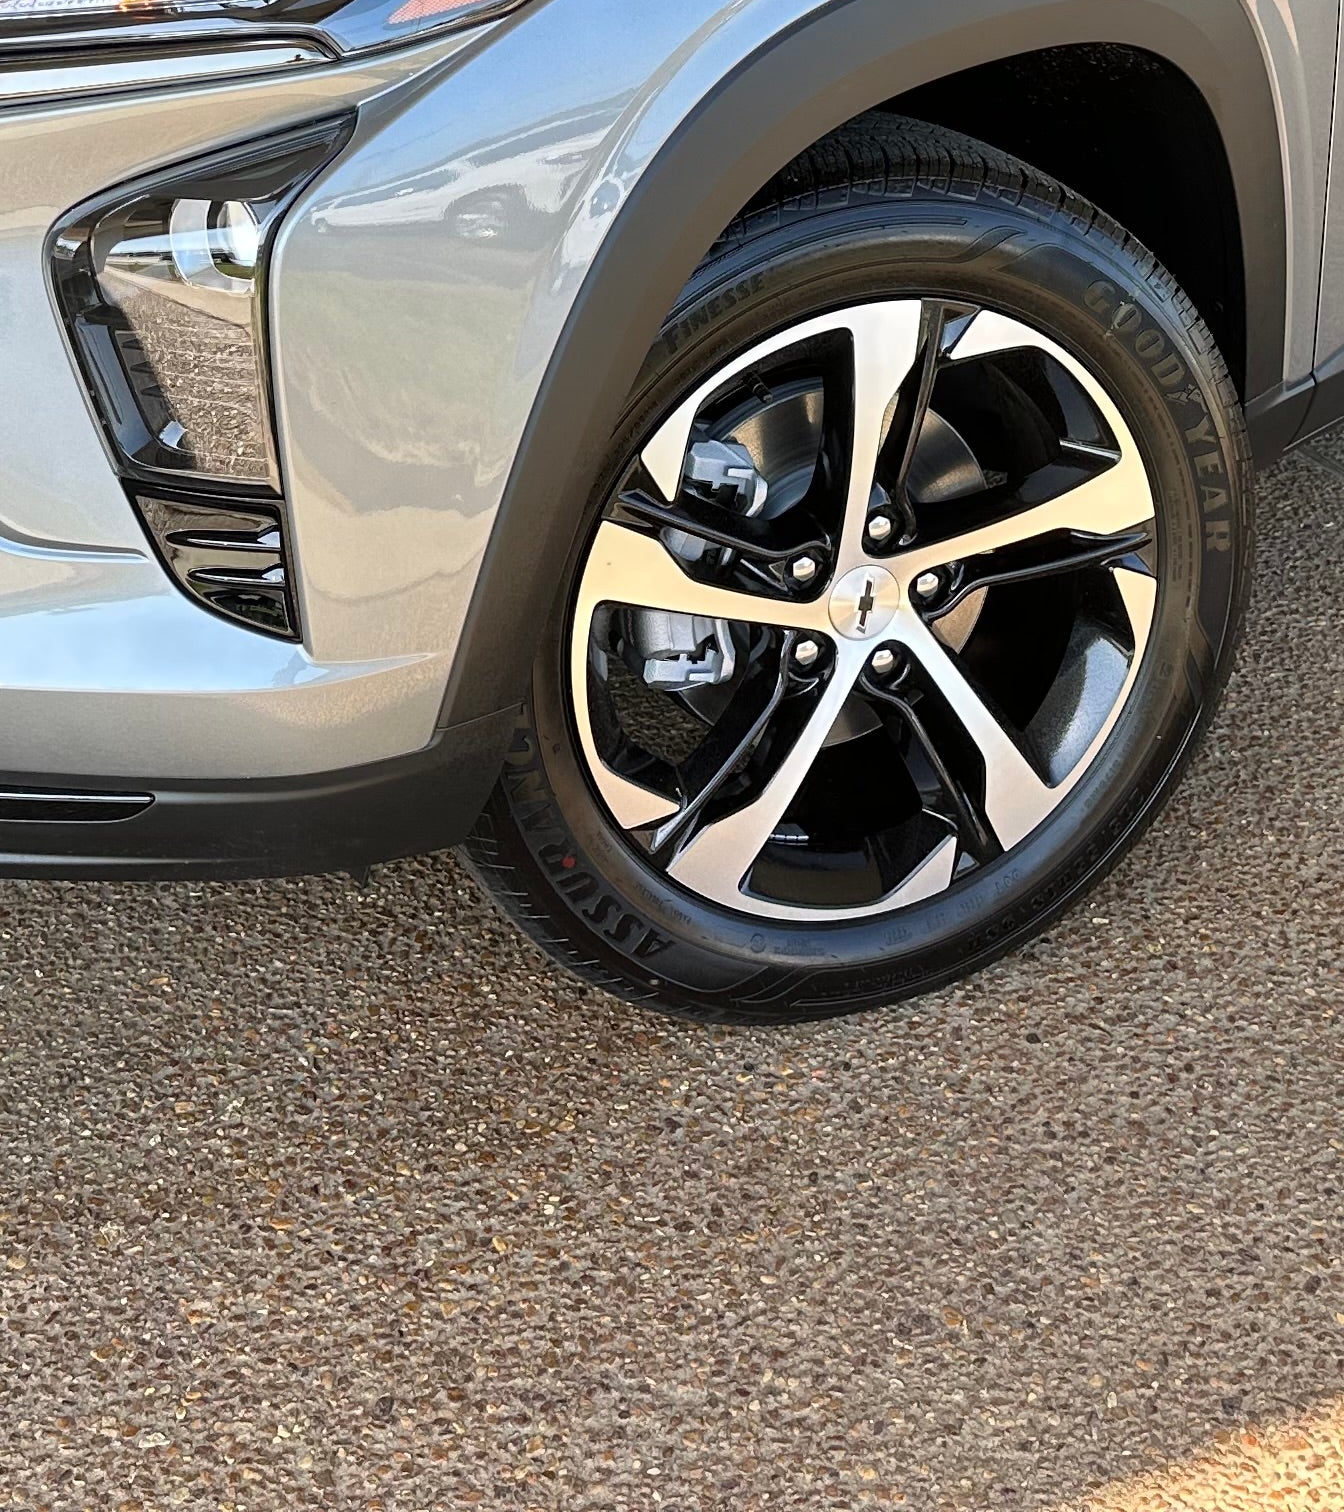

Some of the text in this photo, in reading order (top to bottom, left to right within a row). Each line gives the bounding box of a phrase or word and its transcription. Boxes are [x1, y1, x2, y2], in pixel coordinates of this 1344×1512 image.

[659, 271, 765, 356] FINESSE
[1084, 279, 1232, 553] GOODYEAR
[506, 702, 677, 958] ASSURANC
